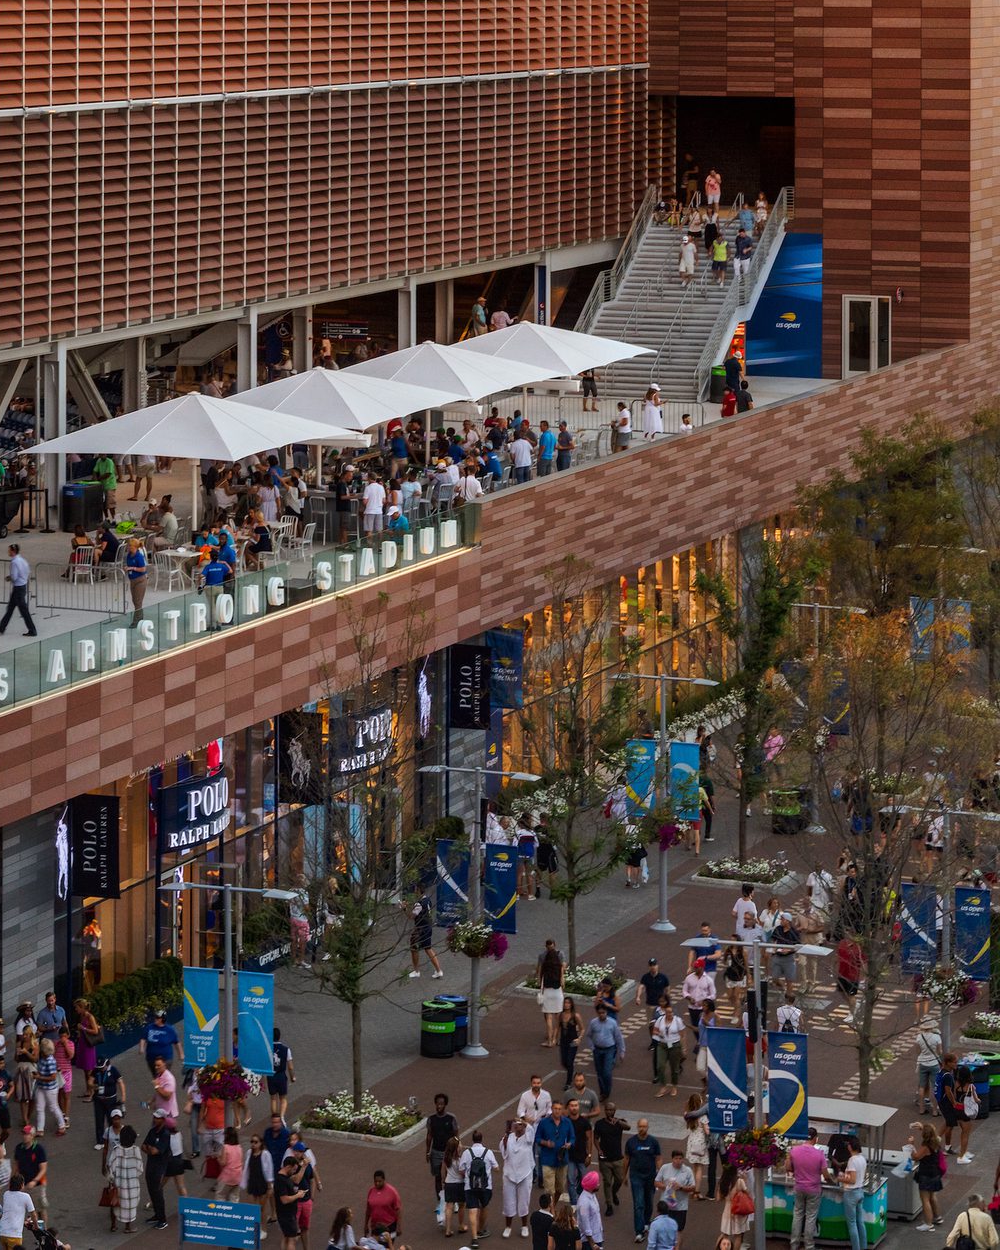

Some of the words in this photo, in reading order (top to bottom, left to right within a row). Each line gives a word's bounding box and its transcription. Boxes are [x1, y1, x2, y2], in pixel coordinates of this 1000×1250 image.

[47, 577, 285, 683] ARMSTRONG
[316, 520, 457, 590] STADIUM
[459, 665, 472, 708] POLO
[187, 777, 229, 822] POLO
[83, 821, 98, 872] POLO
[100, 806, 108, 848] LAUREN
[168, 824, 209, 848] RALPH
[100, 853, 108, 889] RALPH
[497, 861, 513, 869] open
[783, 1053, 801, 1061] open
